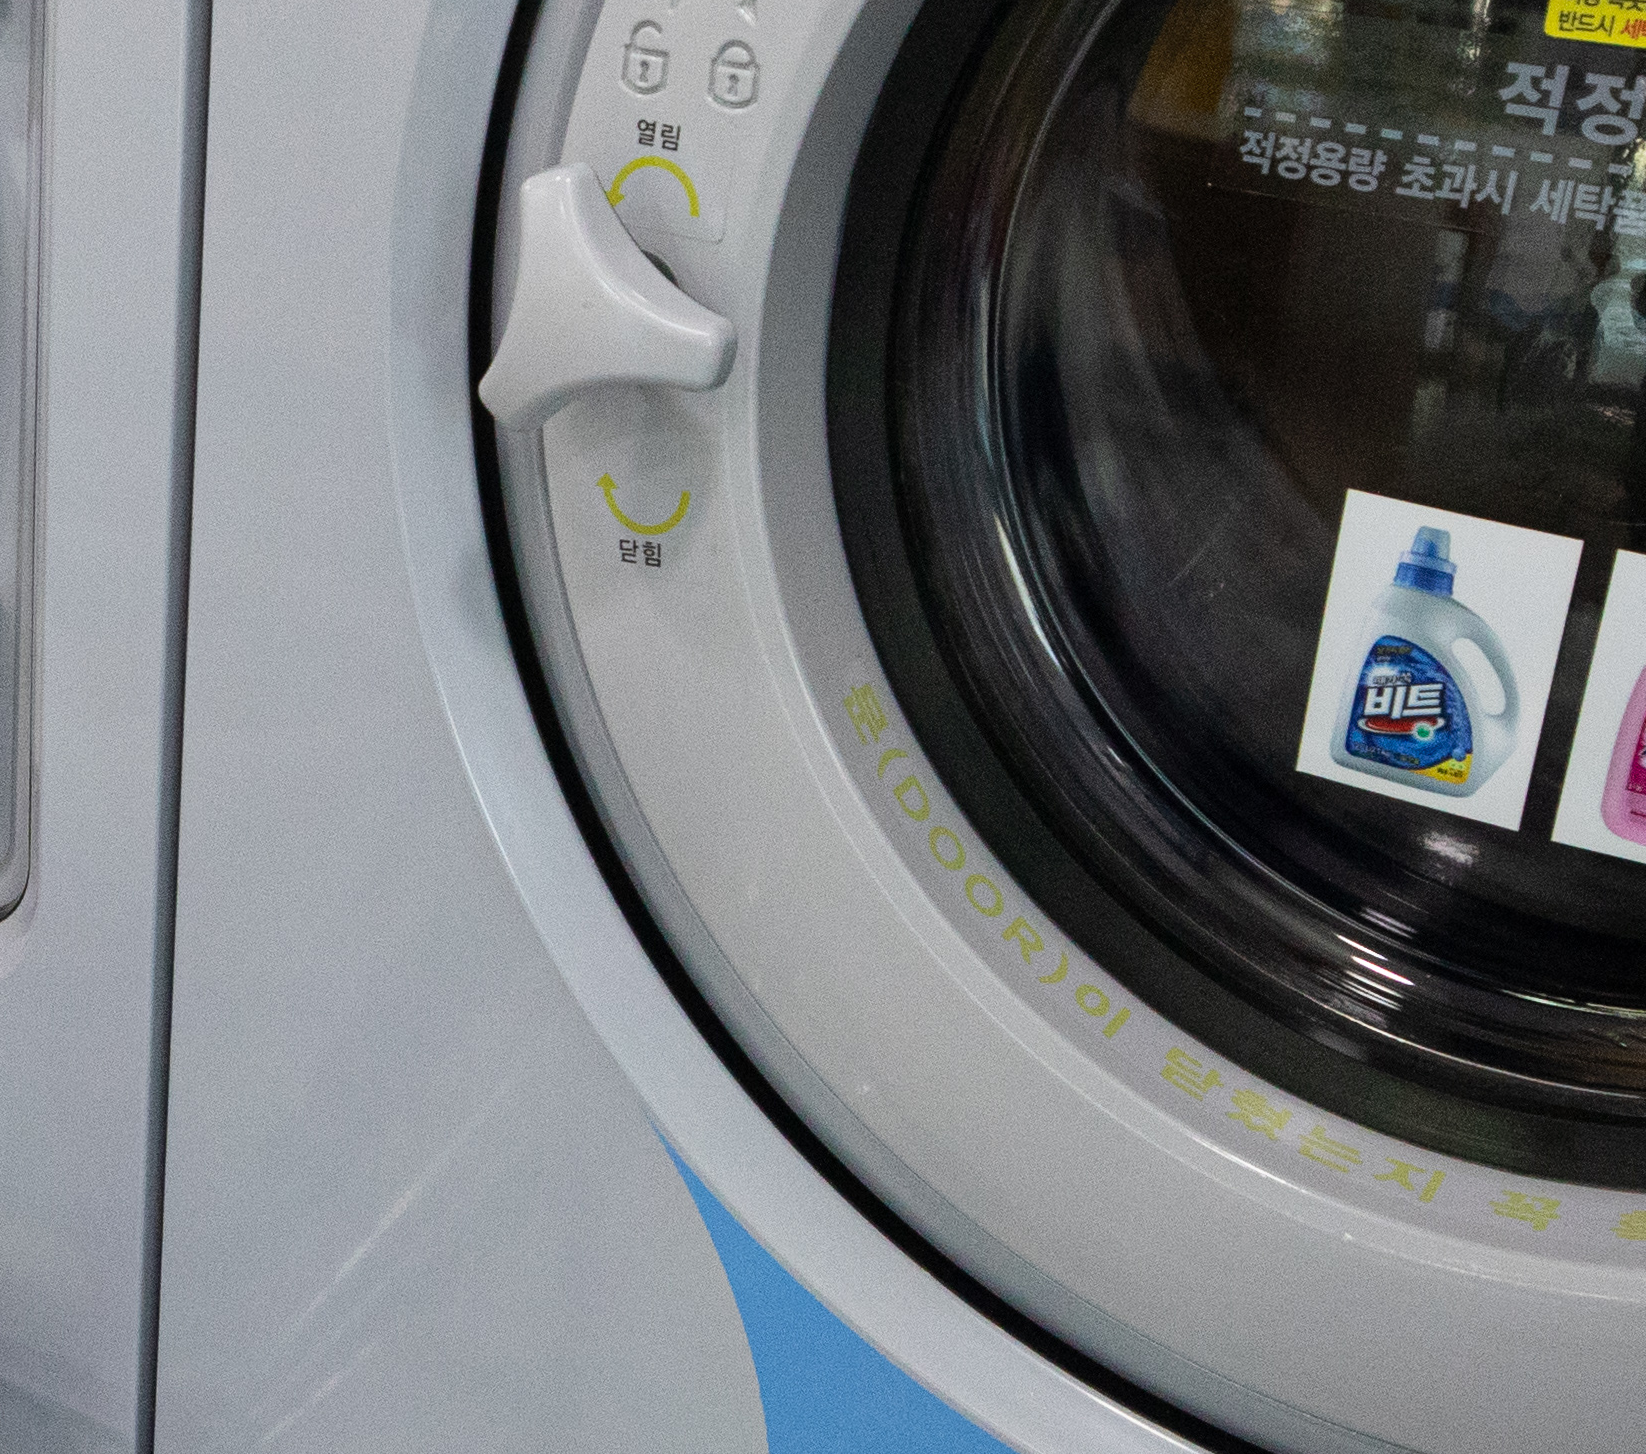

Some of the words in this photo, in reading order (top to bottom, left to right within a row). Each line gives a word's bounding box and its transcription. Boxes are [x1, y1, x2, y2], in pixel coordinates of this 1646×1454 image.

[1559, 10, 1615, 36] 반드시
[636, 118, 681, 152] 열림
[1240, 128, 1388, 192] 적정용량
[1395, 156, 1519, 217] 초과시
[619, 538, 661, 568] 닫힘
[1364, 682, 1444, 721] 비트
[1159, 1047, 1446, 1204] 닫혔는지
